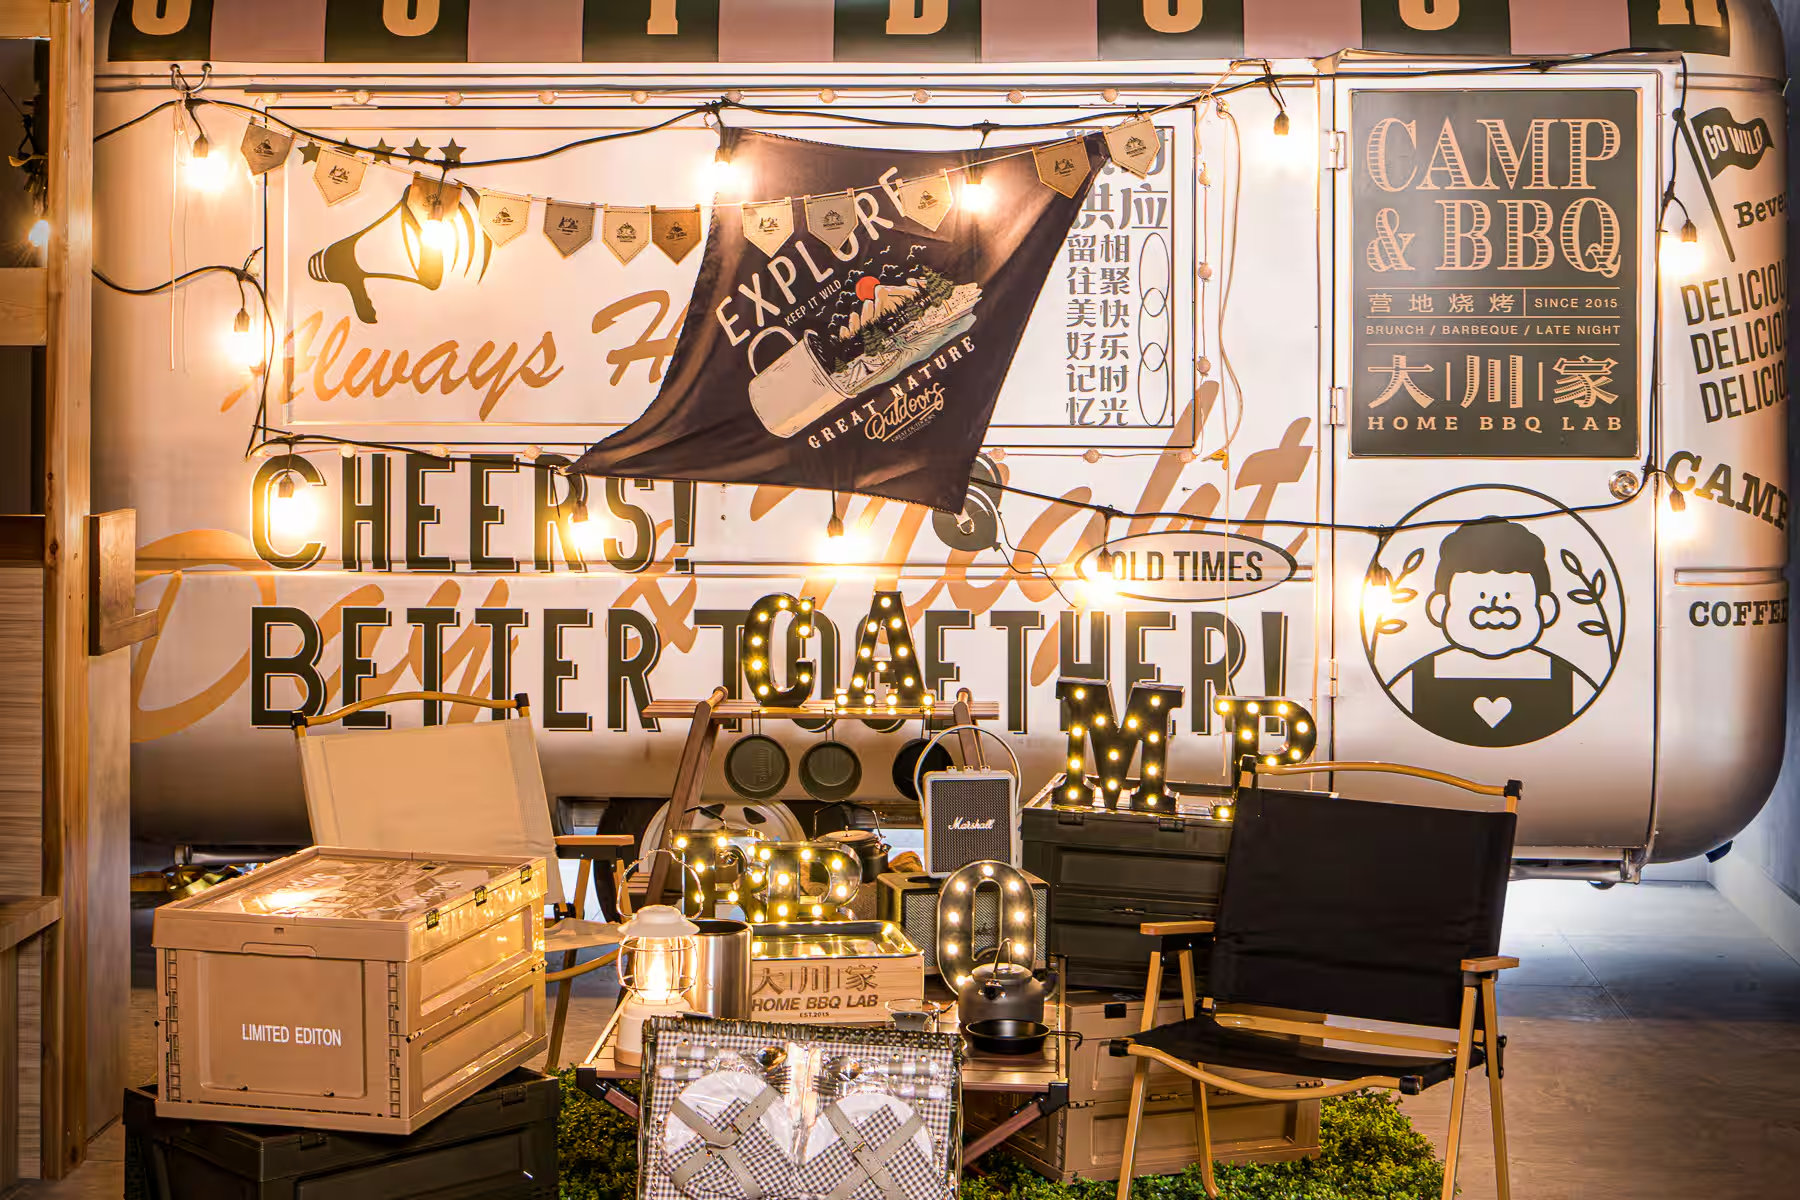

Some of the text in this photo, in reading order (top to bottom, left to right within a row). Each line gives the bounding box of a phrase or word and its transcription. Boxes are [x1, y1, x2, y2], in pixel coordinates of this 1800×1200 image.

[1366, 117, 1621, 192] CAMP
[1702, 125, 1763, 160] GO WILD
[1366, 197, 1621, 278] & BBQ
[784, 279, 842, 327] KEEP IT WILD
[1368, 293, 1515, 313] 营地烧烤
[1534, 298, 1618, 308] SINCE 2015
[1066, 234, 1097, 426] 留住美好记忆
[1100, 234, 1130, 426] 相聚快乐时光
[1366, 325, 1425, 336] BRUNCH
[1442, 325, 1518, 336] BARBEQUE
[1536, 325, 1570, 335] LATE
[1577, 325, 1621, 335] NIGHT
[808, 399, 877, 449] GREAT
[889, 335, 976, 399] NATURE
[864, 382, 946, 440] Outdoors
[1368, 416, 1622, 434] HOME BBQ LAB
[250, 453, 699, 574] CHEERS!
[1111, 551, 1263, 582] OLD TIMES
[250, 606, 662, 733] BETTER
[947, 816, 996, 830] Marshall
[751, 994, 879, 1012] HOME BBQ LAB
[242, 1023, 342, 1047] LIMITED EDITON
